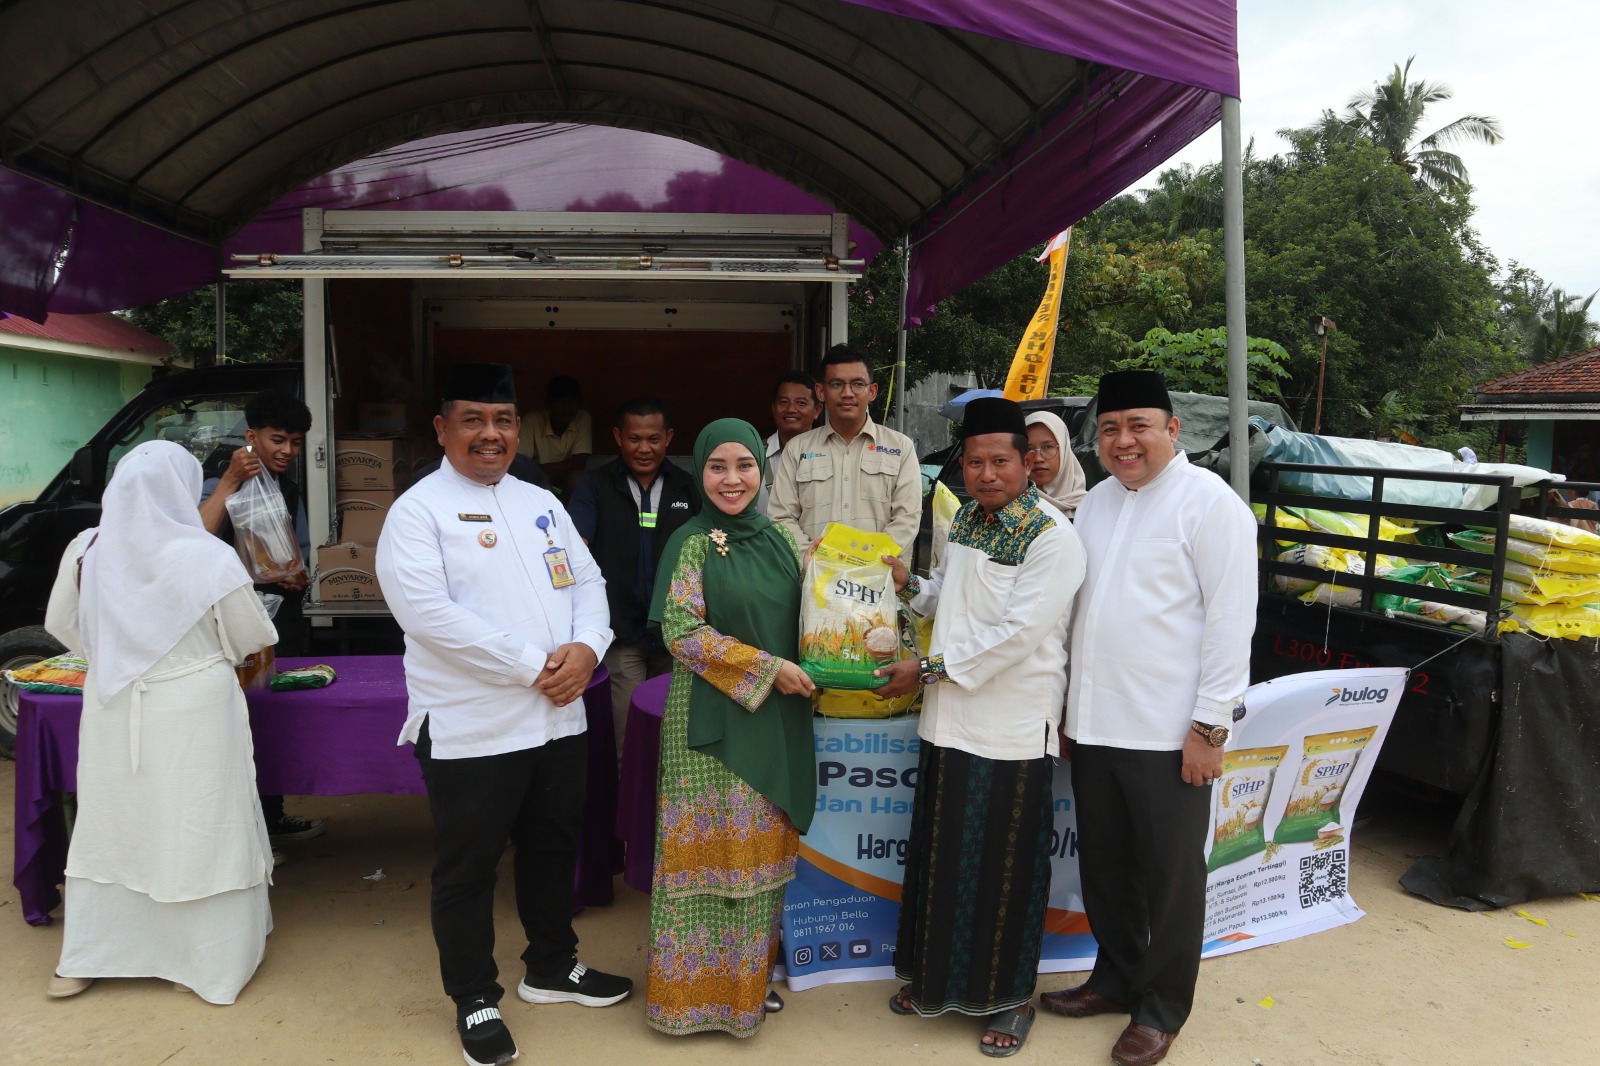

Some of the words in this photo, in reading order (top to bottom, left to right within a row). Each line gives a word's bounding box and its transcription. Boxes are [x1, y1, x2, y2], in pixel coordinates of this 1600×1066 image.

[328, 574, 373, 586] MINYAKITA
[842, 648, 850, 660] 5
[850, 653, 860, 661] kg
[1273, 635, 1332, 666] L300
[1411, 673, 1429, 695] 2
[1341, 686, 1389, 703] bulog
[1314, 763, 1350, 778] SPHP
[1232, 780, 1265, 797] SPHP
[857, 833, 908, 865] Harg
[783, 899, 810, 912] anan
[813, 895, 876, 907] Pengaduan
[793, 912, 838, 926] Hubungi
[841, 910, 869, 920] Bella
[1229, 921, 1246, 931] Papua
[793, 927, 812, 938] 0811
[815, 924, 836, 934] 1967
[838, 922, 855, 932] 016
